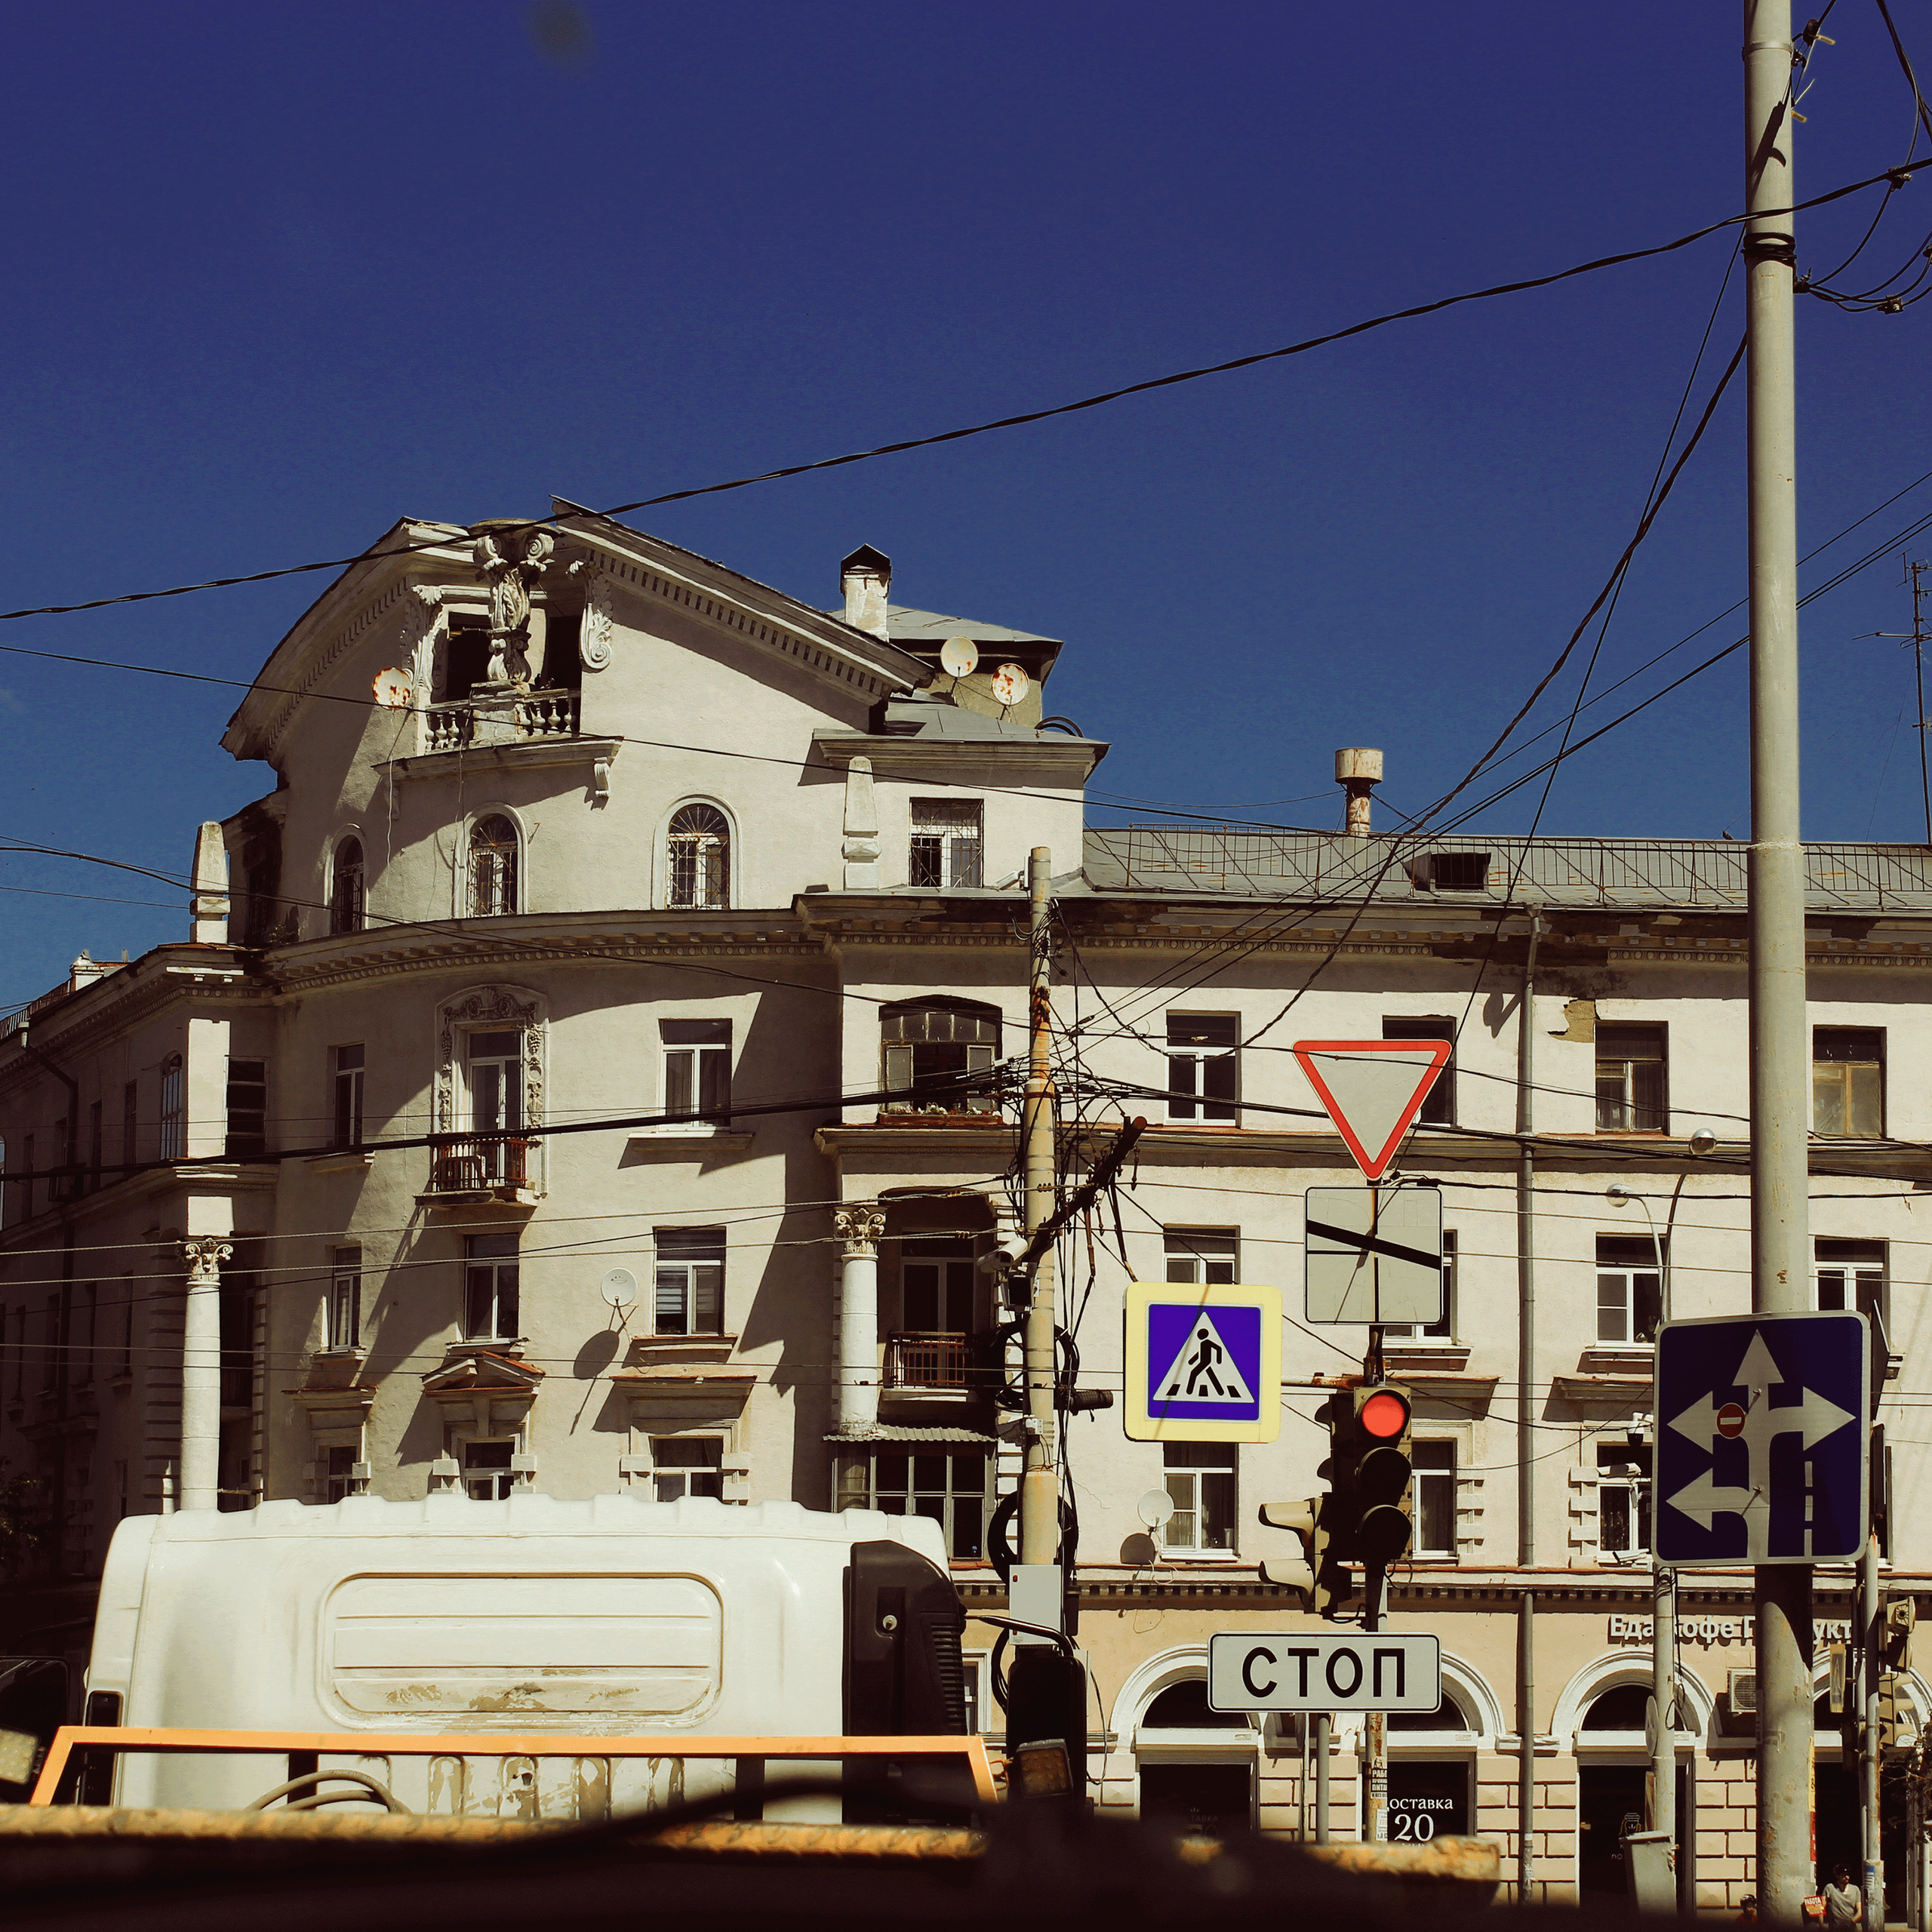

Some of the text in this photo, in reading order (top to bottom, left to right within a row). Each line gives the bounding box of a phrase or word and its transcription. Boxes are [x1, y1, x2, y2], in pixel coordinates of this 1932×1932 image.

[1611, 1614, 1654, 1640] Еда
[1242, 1647, 1405, 1698] СТОП
[1387, 1798, 1454, 1812] оставка
[1394, 1814, 1434, 1842] 20
